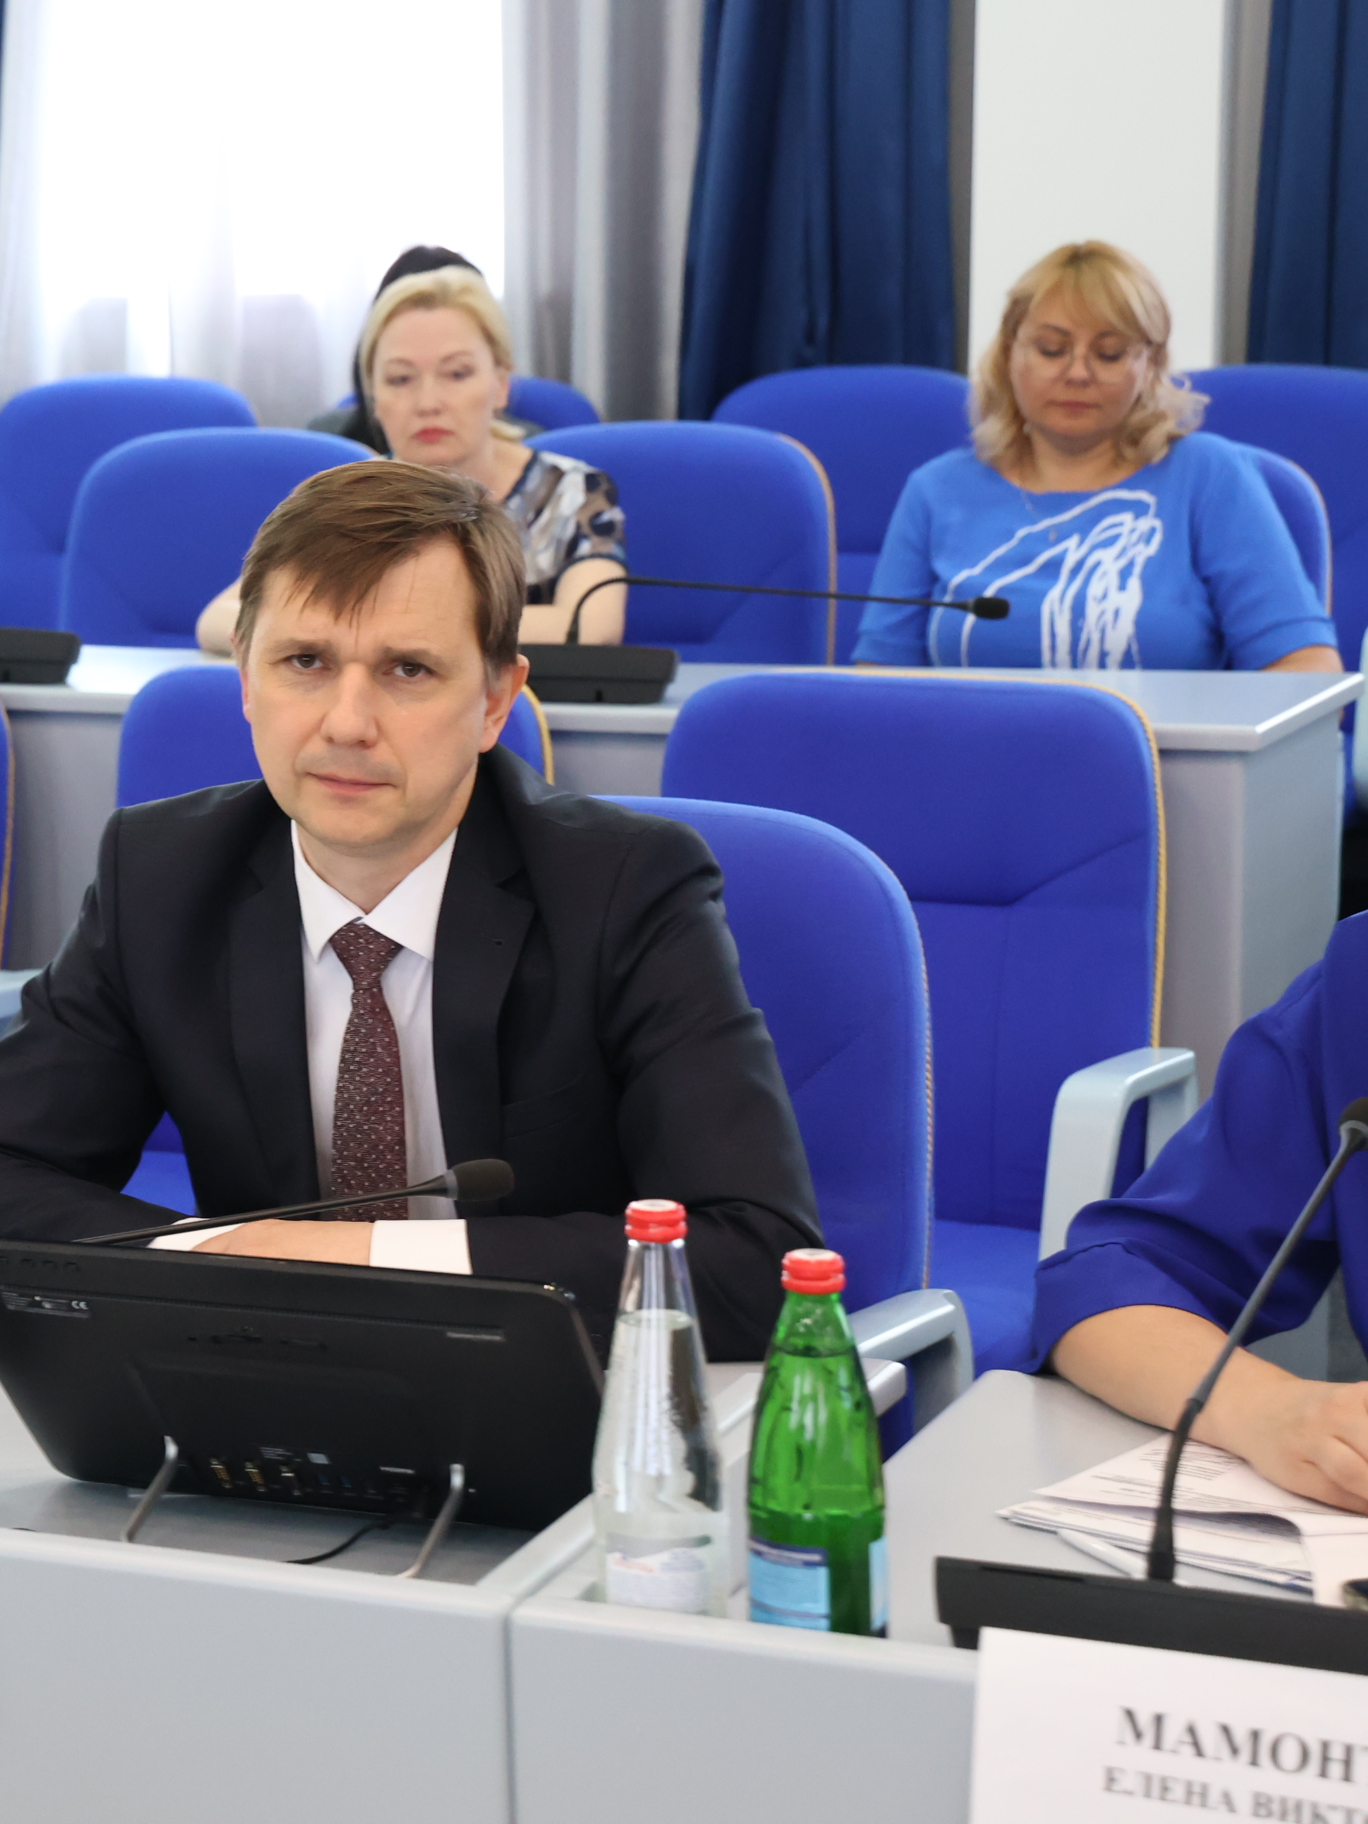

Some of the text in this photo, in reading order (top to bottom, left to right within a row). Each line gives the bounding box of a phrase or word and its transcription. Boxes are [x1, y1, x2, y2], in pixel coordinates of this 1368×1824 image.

[1117, 1706, 1368, 1783] МАМОН
[1103, 1765, 1368, 1824] ЕЛЕНА ВИКТ
